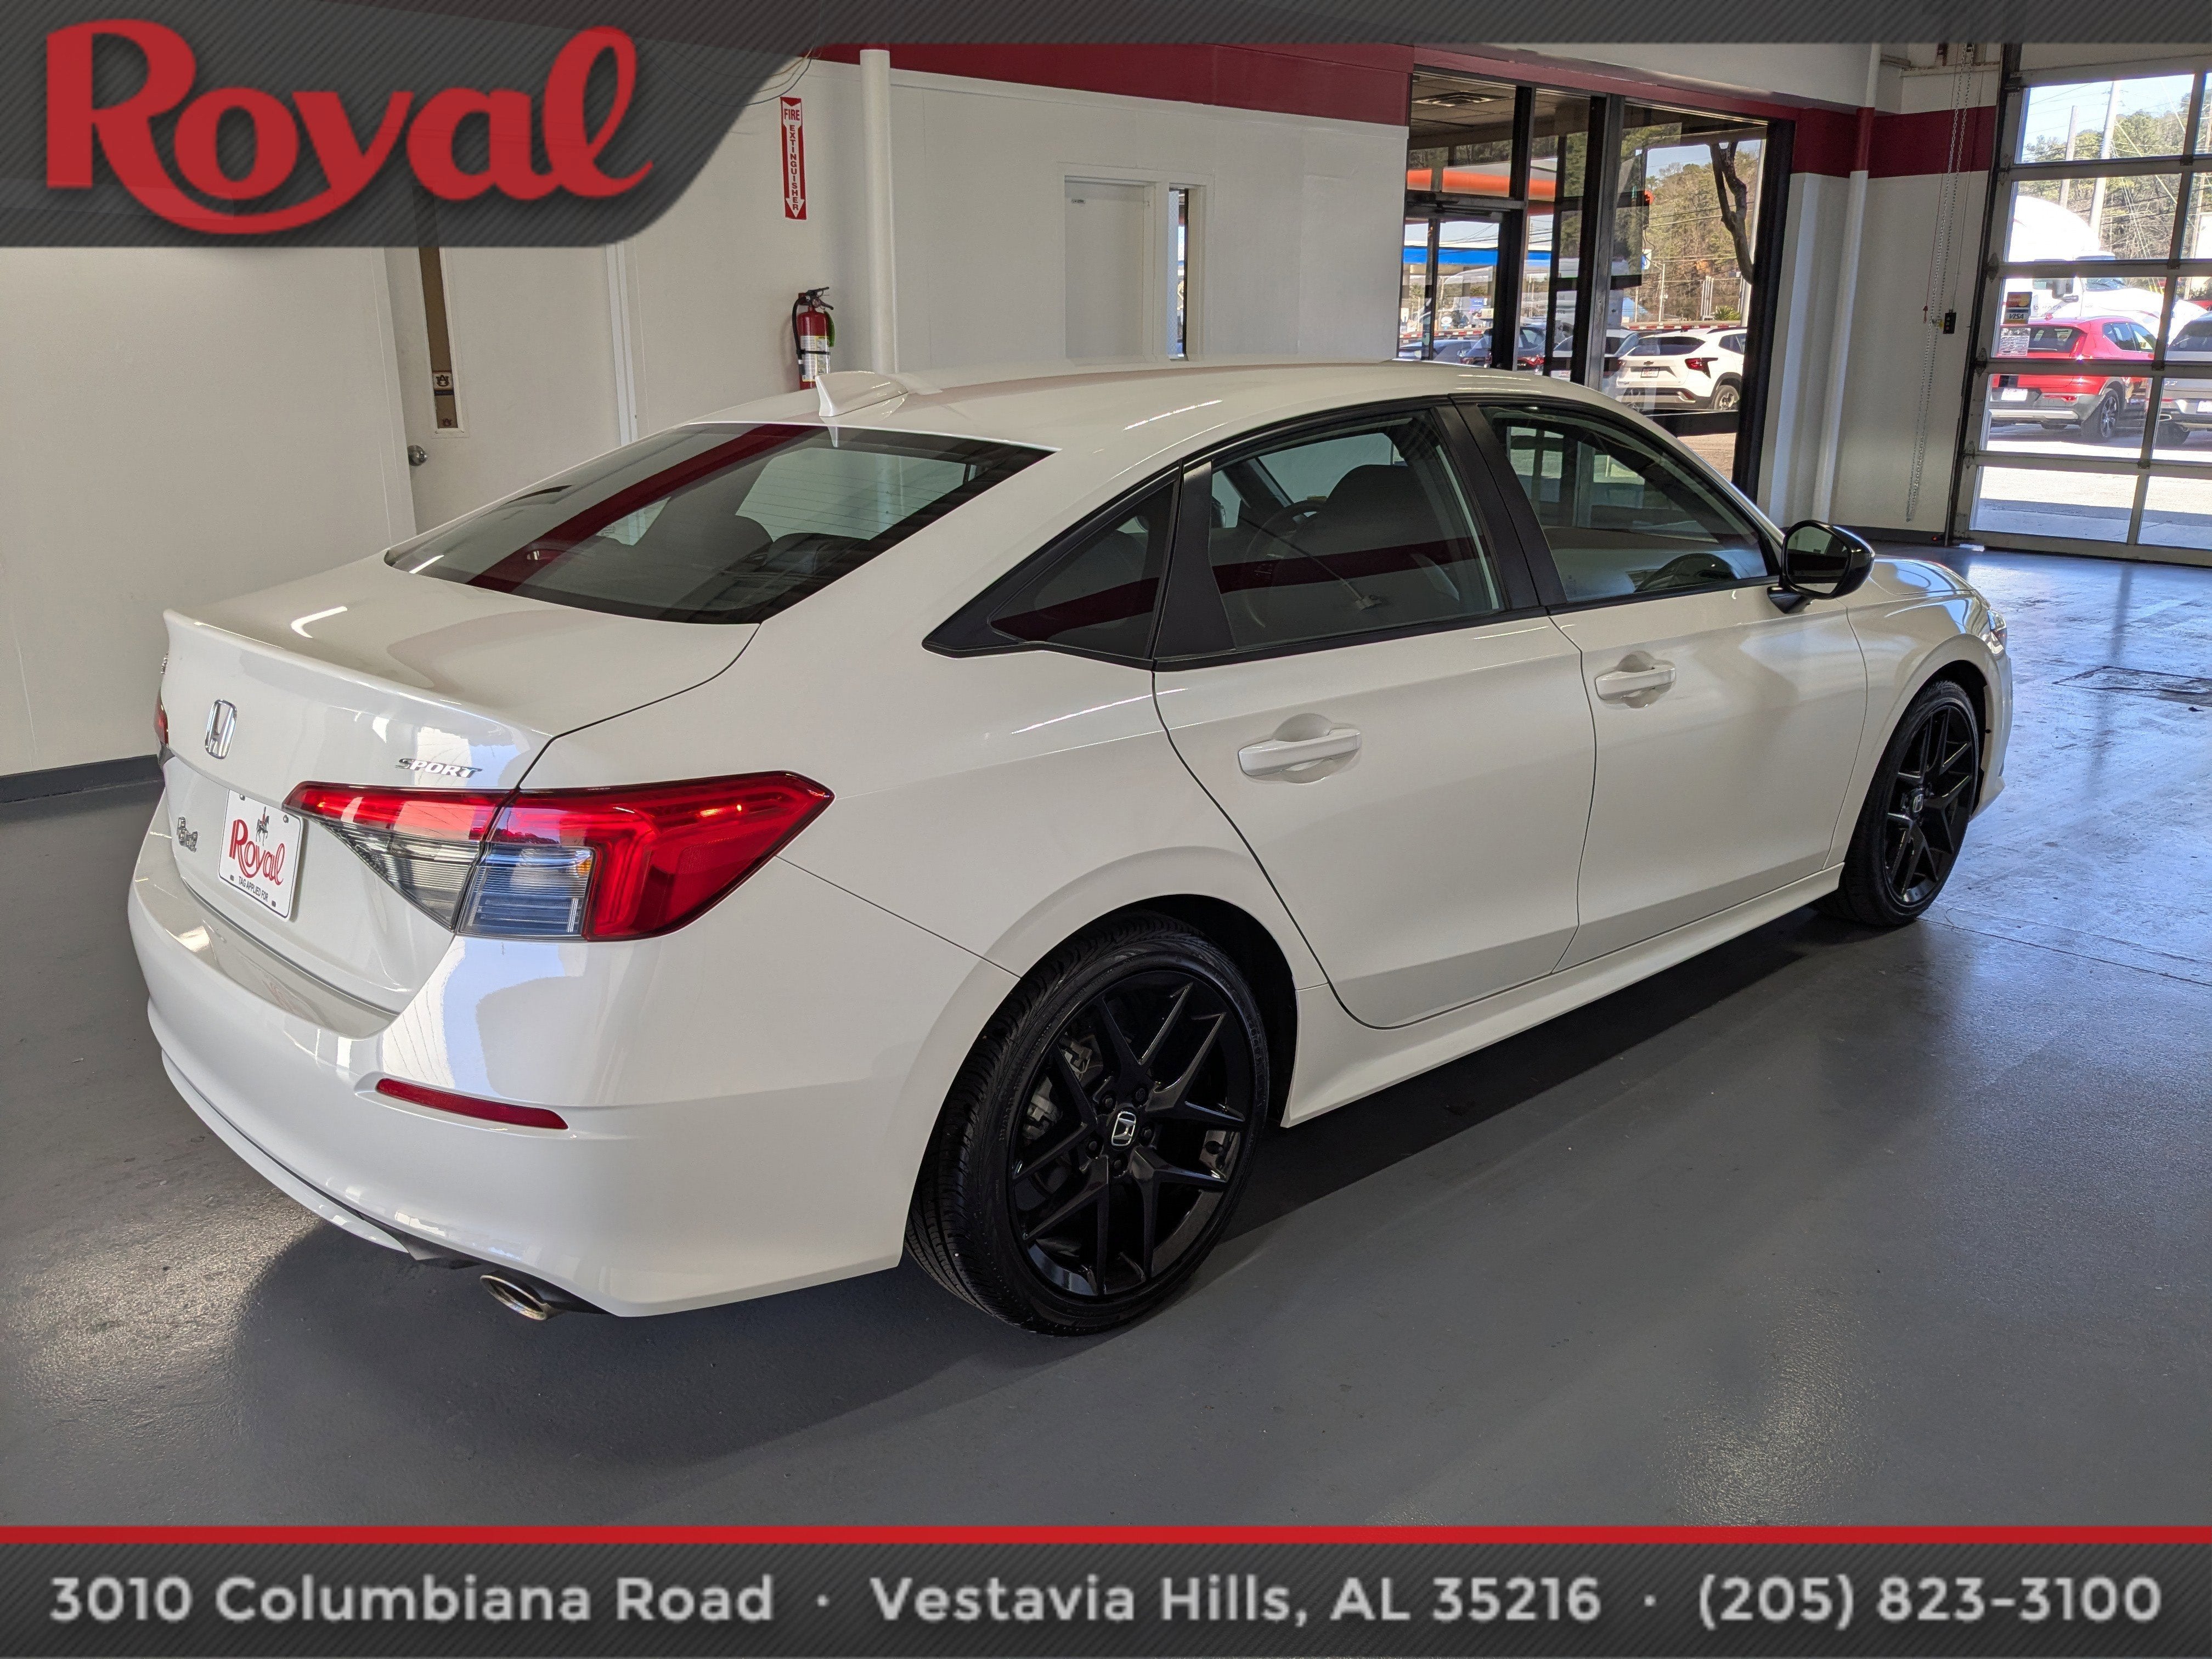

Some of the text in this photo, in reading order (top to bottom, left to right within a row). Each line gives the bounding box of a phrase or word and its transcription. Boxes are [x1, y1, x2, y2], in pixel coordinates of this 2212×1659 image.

[784, 108, 800, 121] FIRE
[789, 124, 799, 211] EXTINGUISHER
[396, 758, 483, 778] SPORT
[229, 819, 285, 885] Royal
[238, 876, 269, 902] TAG APPLIED FOR
